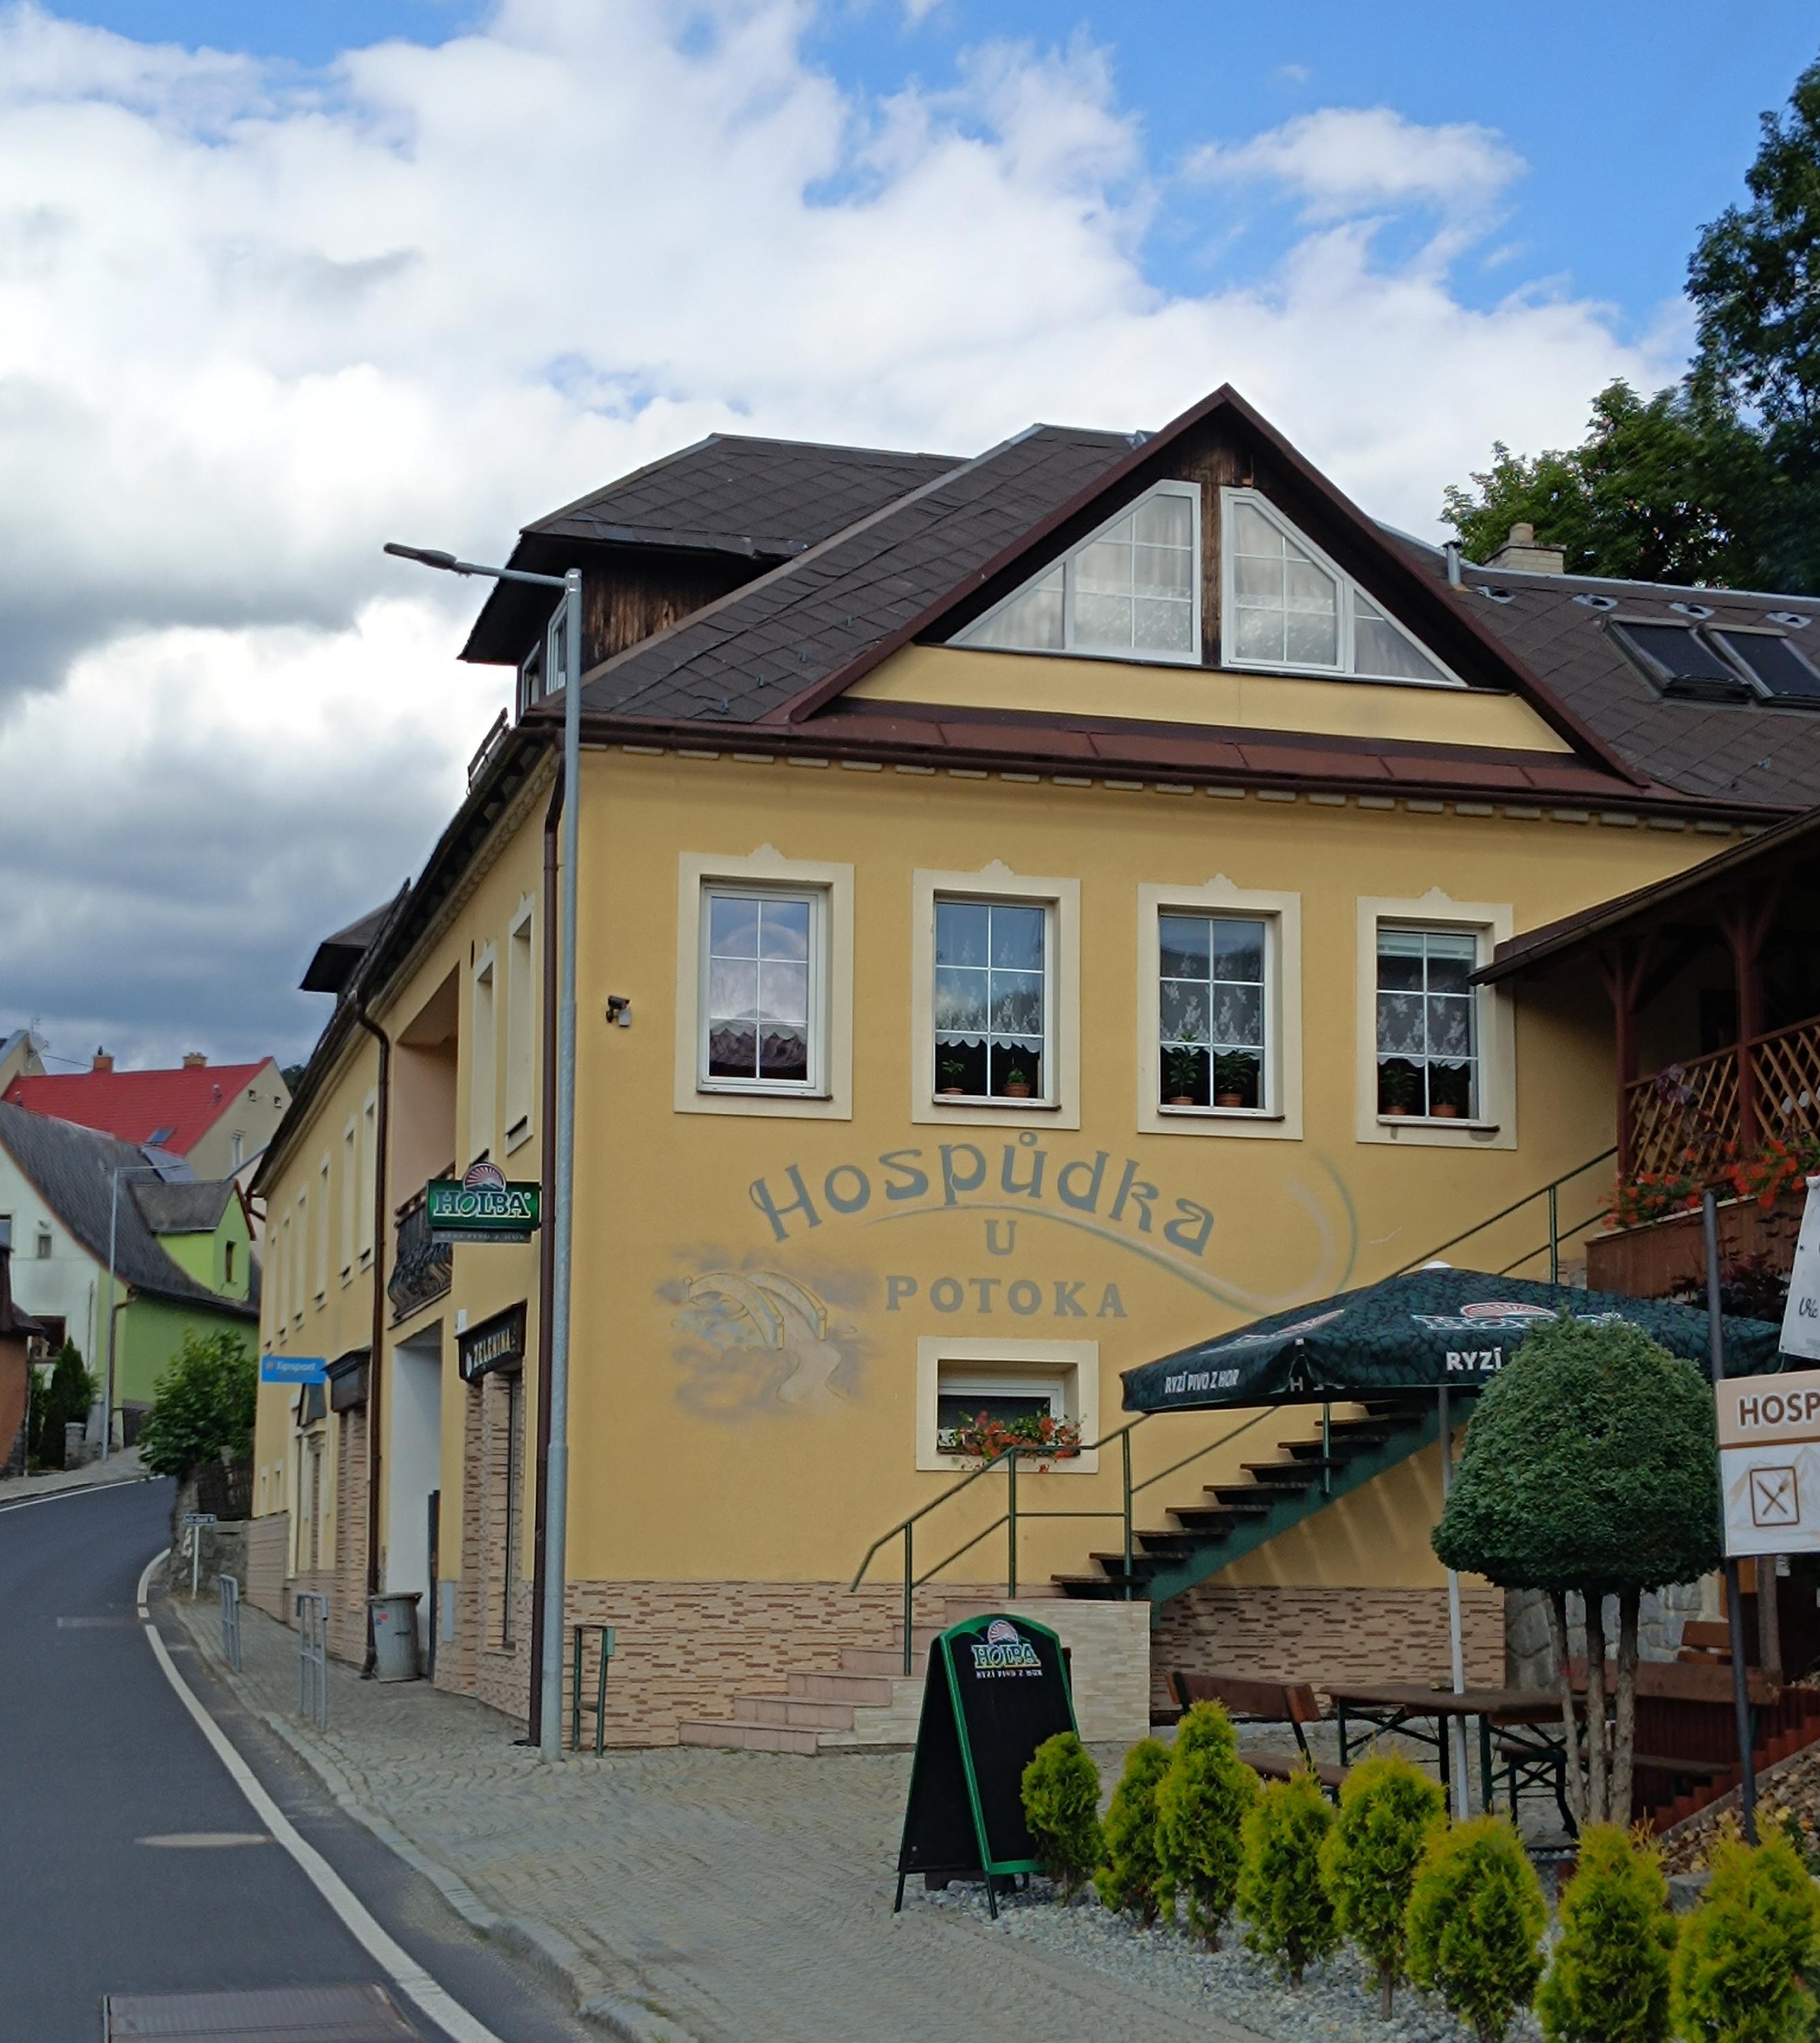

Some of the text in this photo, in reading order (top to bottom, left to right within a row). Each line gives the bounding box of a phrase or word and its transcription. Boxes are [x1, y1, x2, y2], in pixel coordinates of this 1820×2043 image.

[750, 1131, 1214, 1256] Hospůdka
[985, 1220, 1017, 1256] U
[886, 1275, 1128, 1318] POTOKA
[1446, 1346, 1502, 1372] RYZÍ
[1187, 1372, 1210, 1392] PIVO
[1210, 1371, 1217, 1389] Z
[1218, 1369, 1240, 1388] HOR
[1740, 1392, 1820, 1426] HOSP
